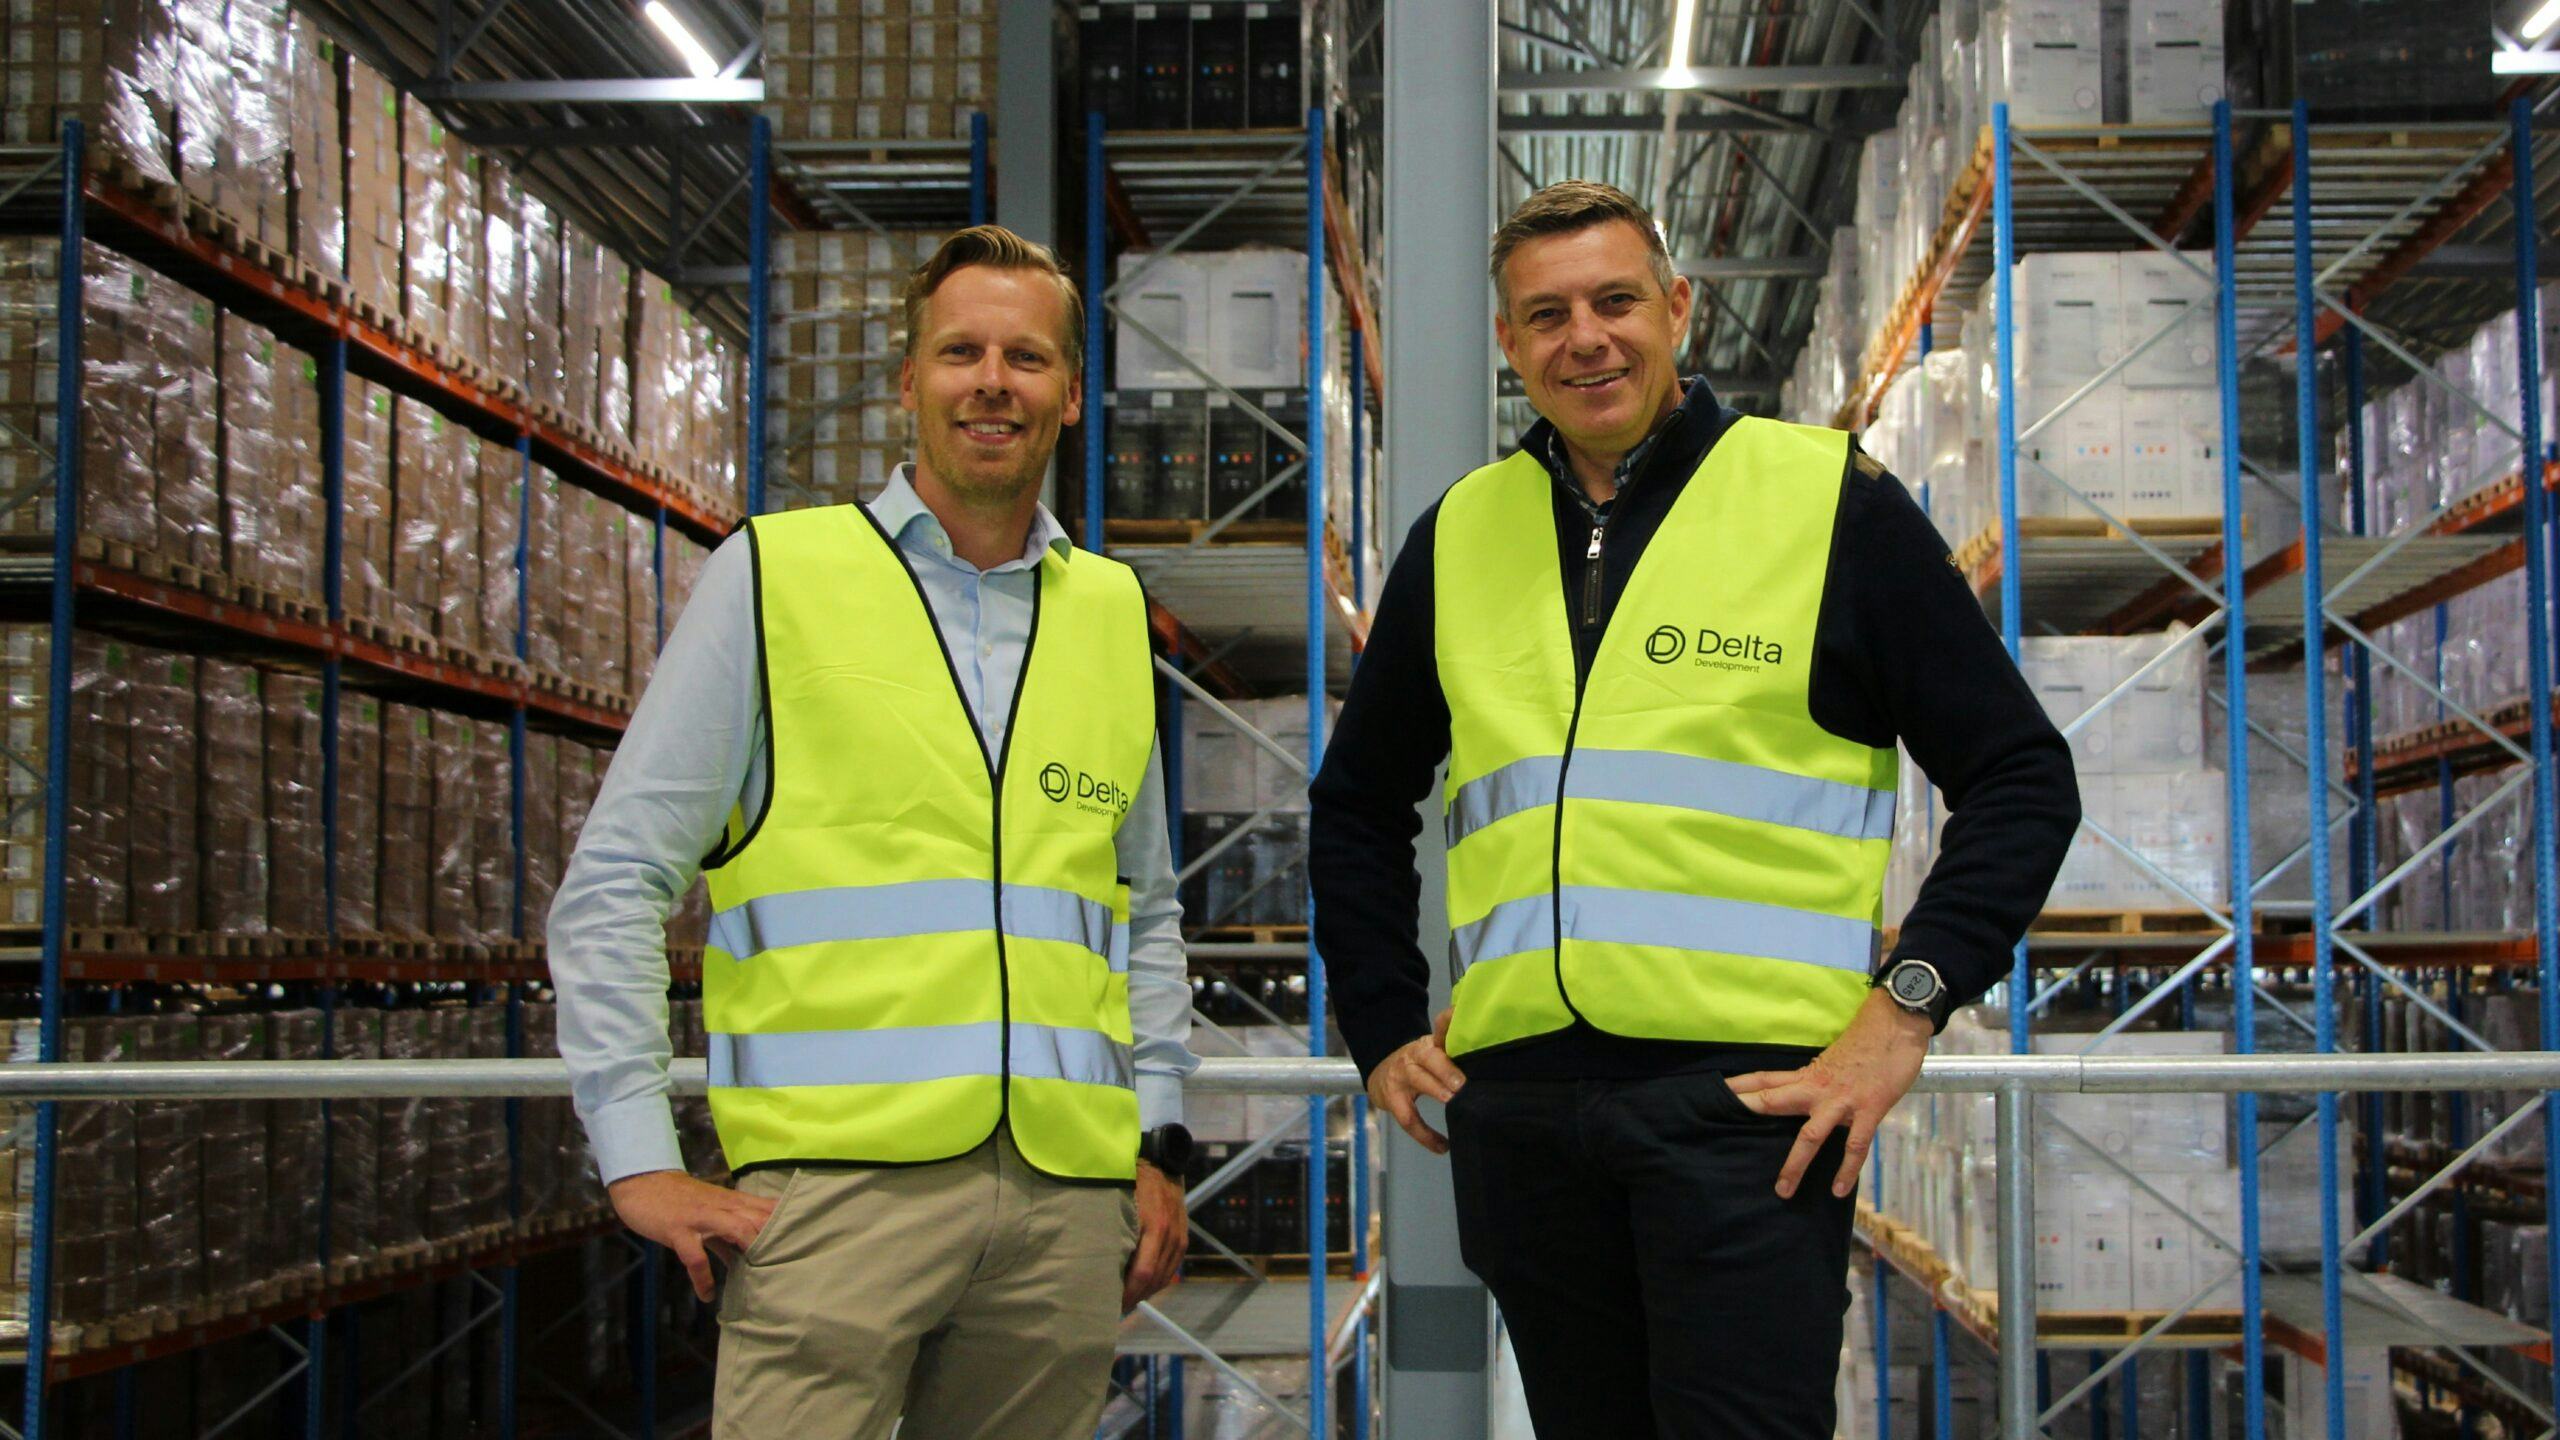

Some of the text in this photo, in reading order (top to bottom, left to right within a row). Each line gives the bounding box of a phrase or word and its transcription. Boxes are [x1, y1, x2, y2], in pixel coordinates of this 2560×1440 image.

[1697, 629, 1783, 665] Delta
[1695, 658, 1760, 673] Development
[1077, 771, 1128, 813] Delta
[1076, 801, 1118, 817] Developm
